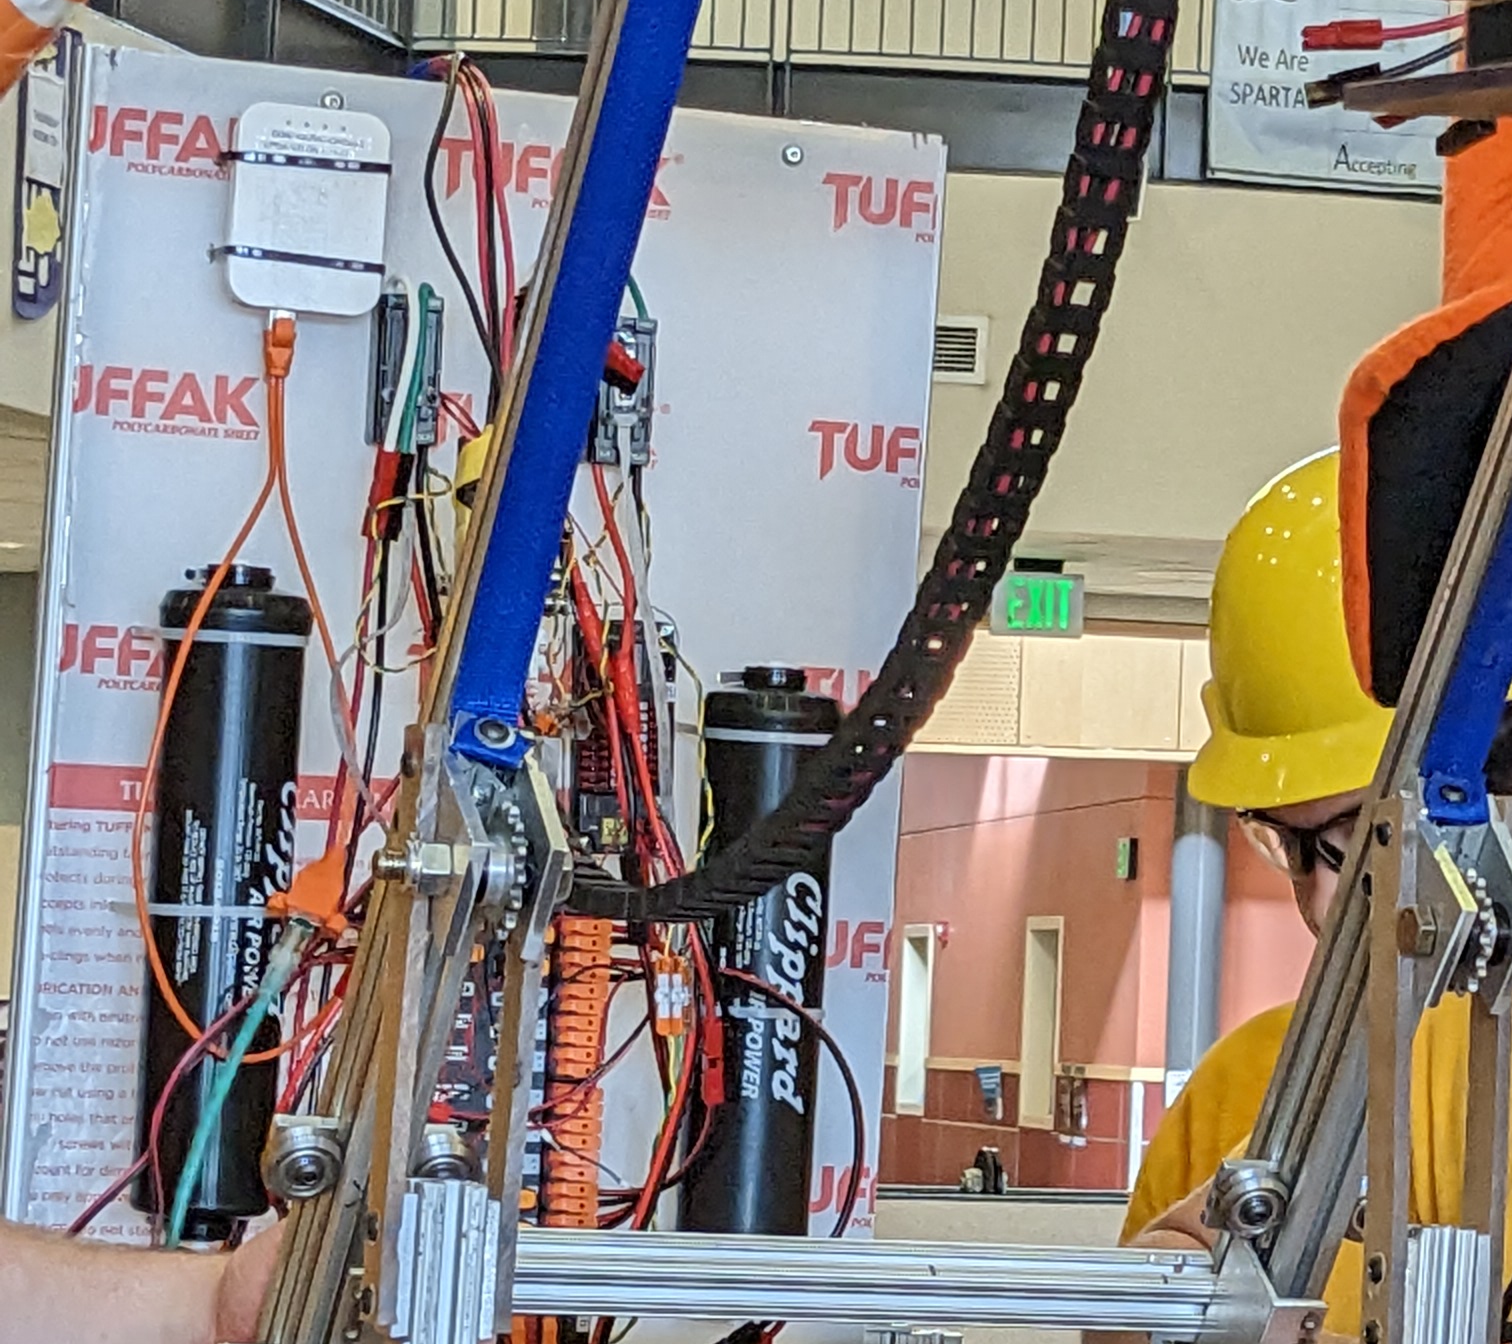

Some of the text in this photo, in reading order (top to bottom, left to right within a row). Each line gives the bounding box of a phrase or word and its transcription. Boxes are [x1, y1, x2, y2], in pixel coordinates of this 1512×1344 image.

[1237, 44, 1310, 73] We Are
[1229, 83, 1306, 109] SPARTA
[1333, 143, 1418, 181] Accepting
[821, 171, 938, 233] TUF
[807, 419, 922, 481] TUF
[1006, 577, 1074, 631] EXIT
